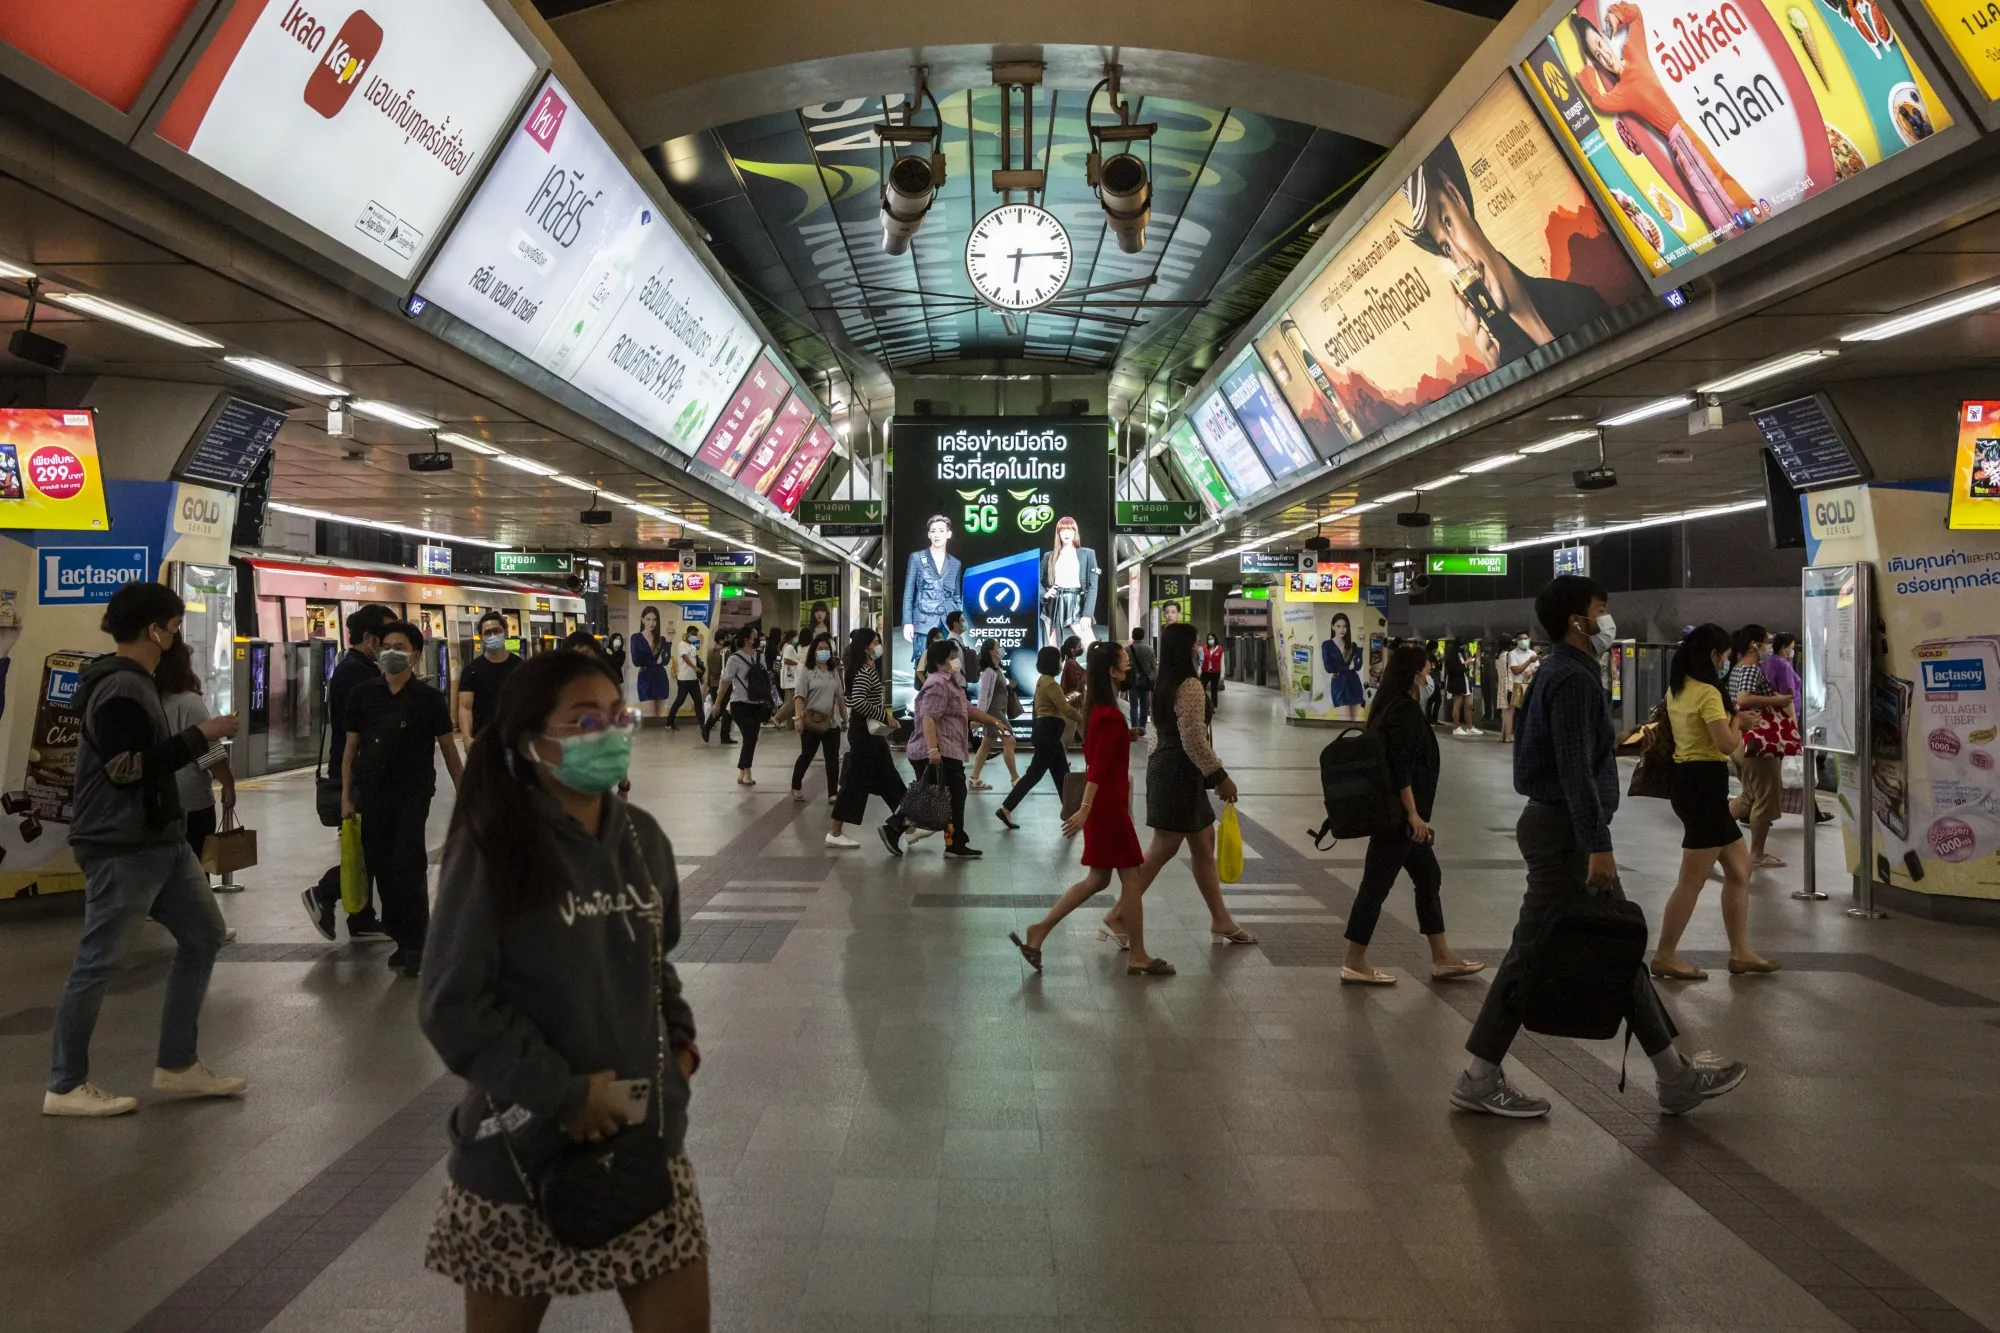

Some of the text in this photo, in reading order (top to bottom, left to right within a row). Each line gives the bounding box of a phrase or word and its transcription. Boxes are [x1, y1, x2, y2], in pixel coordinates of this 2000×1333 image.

[1961, 17, 1975, 35] 1
[1653, 2, 1748, 83] อิ่มให้สุด
[324, 38, 366, 84] Kept
[532, 96, 560, 140] ใหม่
[1564, 97, 1585, 122] krungsri
[1693, 72, 1785, 148] ทั่วโลก
[1495, 119, 1531, 157] COLOMBIA
[1508, 139, 1538, 170] ARABICA
[1479, 172, 1498, 193] GOLD
[1772, 176, 1814, 206] KrungsriCard
[525, 164, 603, 248] เคลียร์
[1487, 188, 1517, 217] CREMA
[469, 265, 543, 324] คลีน แอนด์ มายด์
[1324, 266, 1431, 367] รสชาติที่อยากให้คุณลอง
[608, 333, 663, 386] ลดแบคทีเรีย
[937, 429, 1067, 452] เครือข่ายมือถือ
[33, 453, 75, 466] เพียงใบละ
[36, 465, 69, 482] 299
[937, 452, 1066, 485] เร็วที่สุดในไทย
[814, 503, 851, 511] ทางออก
[978, 494, 998, 504] AIS
[1029, 494, 1050, 504] AIS
[1132, 503, 1169, 512] ทางออก
[182, 497, 220, 524] GOLD
[815, 513, 832, 521] Exit
[964, 505, 998, 533] 5G
[1019, 506, 1052, 530] 4G
[1815, 499, 1856, 526] GOLD
[187, 523, 212, 533] SERIES
[1826, 526, 1850, 536] SERIES
[500, 555, 536, 565] ทางออก
[686, 558, 692, 567] 2
[1305, 559, 1311, 567] 4
[1469, 557, 1501, 566] ทางออก
[44, 556, 143, 598] Lactasoy
[814, 584, 827, 595] 5G
[1164, 584, 1178, 595] 5G
[986, 615, 1011, 624] OOKLA
[969, 628, 1027, 638] SPEEDTEST
[975, 638, 1022, 648] ARDS
[52, 660, 75, 668] GOLD
[1924, 665, 1983, 688] Lactasoy
[1931, 704, 1988, 714] COLLAGEN
[58, 715, 81, 726] EXTR
[1944, 715, 1975, 725] FIBER
[1930, 734, 1960, 748] Collagen
[1930, 828, 1969, 844] Collagen
